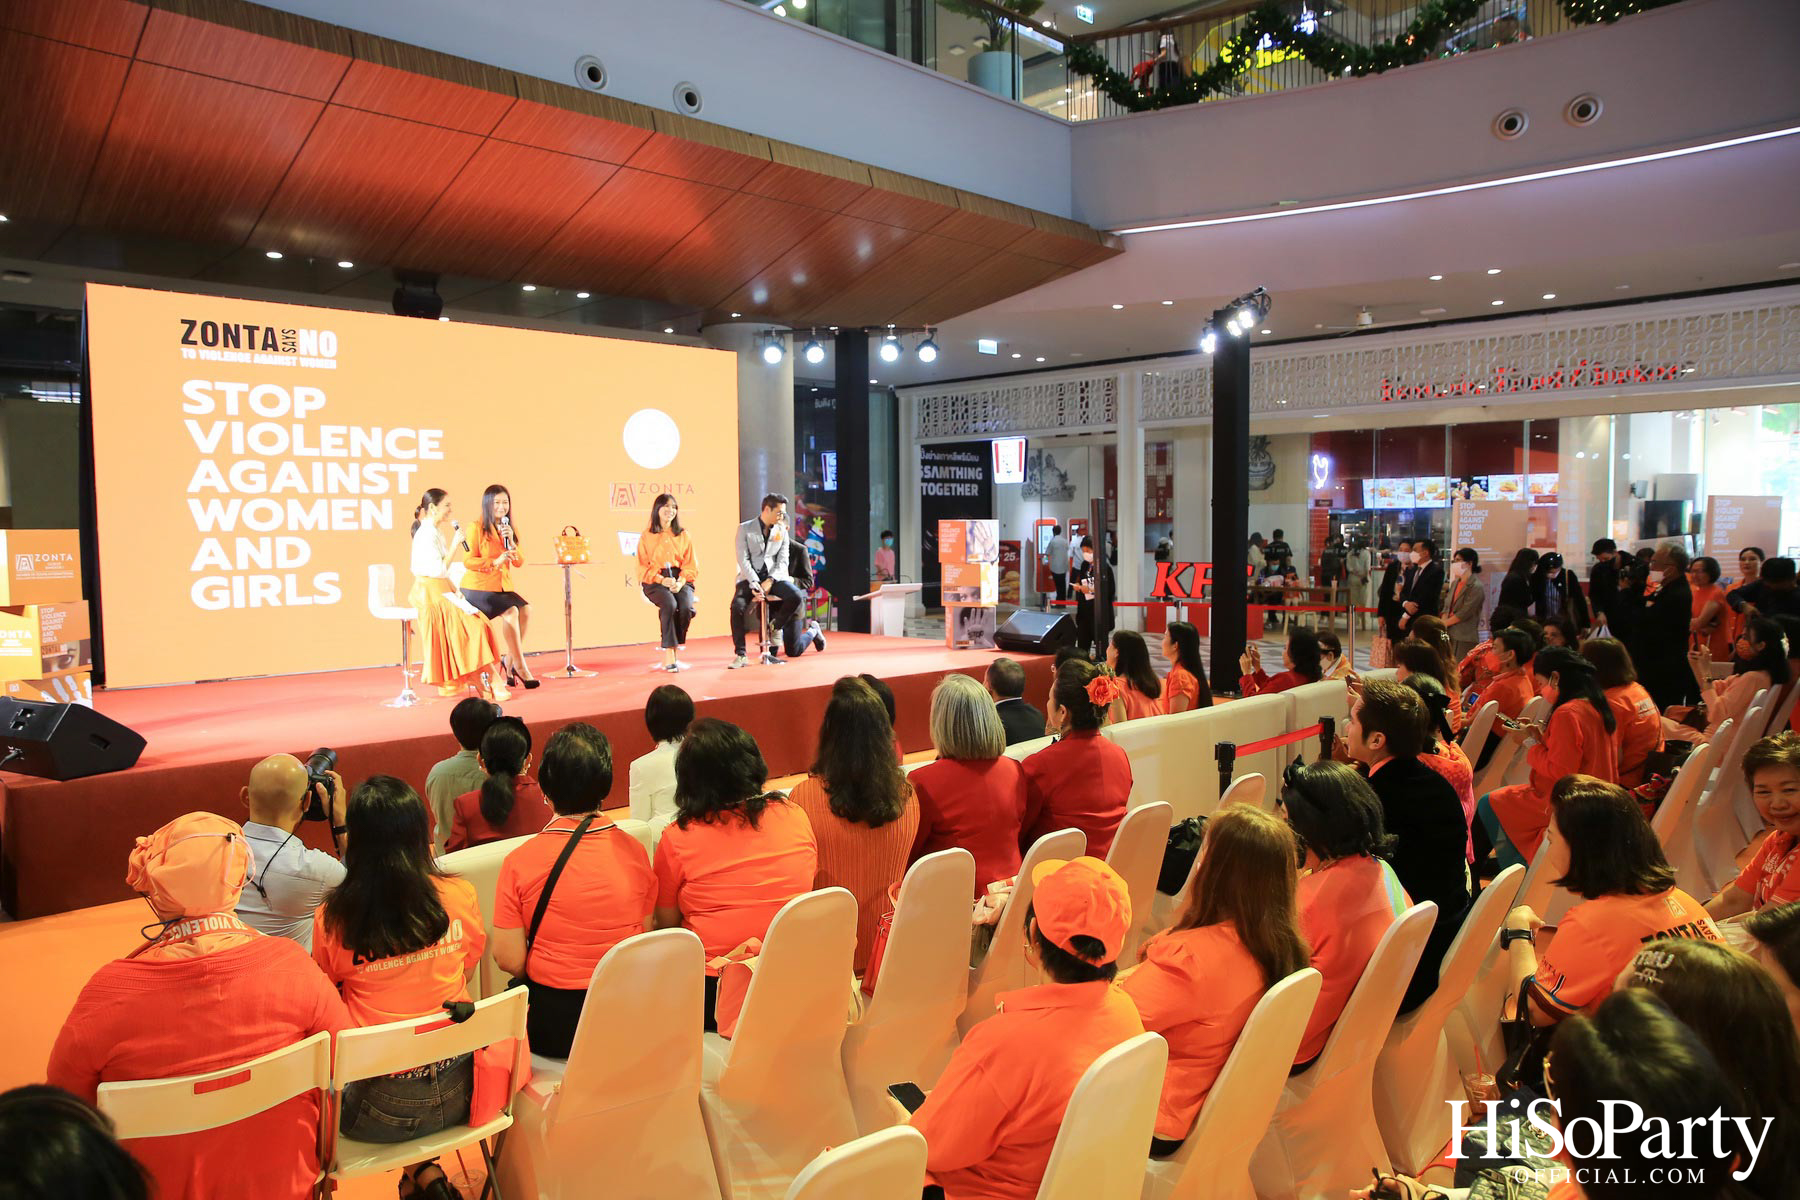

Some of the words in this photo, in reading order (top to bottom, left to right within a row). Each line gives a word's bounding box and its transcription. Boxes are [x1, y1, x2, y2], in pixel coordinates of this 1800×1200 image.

[180, 319, 280, 352] ZONTA
[281, 328, 297, 353] SAYS
[299, 329, 338, 359] NO
[180, 347, 197, 360] TO
[199, 349, 252, 364] VIOLENCE
[253, 354, 298, 367] AGAINST
[300, 356, 337, 370] WOMEN
[182, 379, 327, 419] STOP
[183, 419, 444, 460] VIOLENCE
[187, 459, 418, 494] AGAINST
[639, 483, 695, 495] ZONTA
[921, 482, 979, 496] TOGETHER
[187, 498, 393, 532] WOMEN
[34, 553, 73, 562] ZONTA
[190, 536, 312, 571] AND
[191, 571, 343, 611] GIRLS
[365, 957, 404, 973] VIOLENCE
[406, 949, 439, 965] AGAINST
